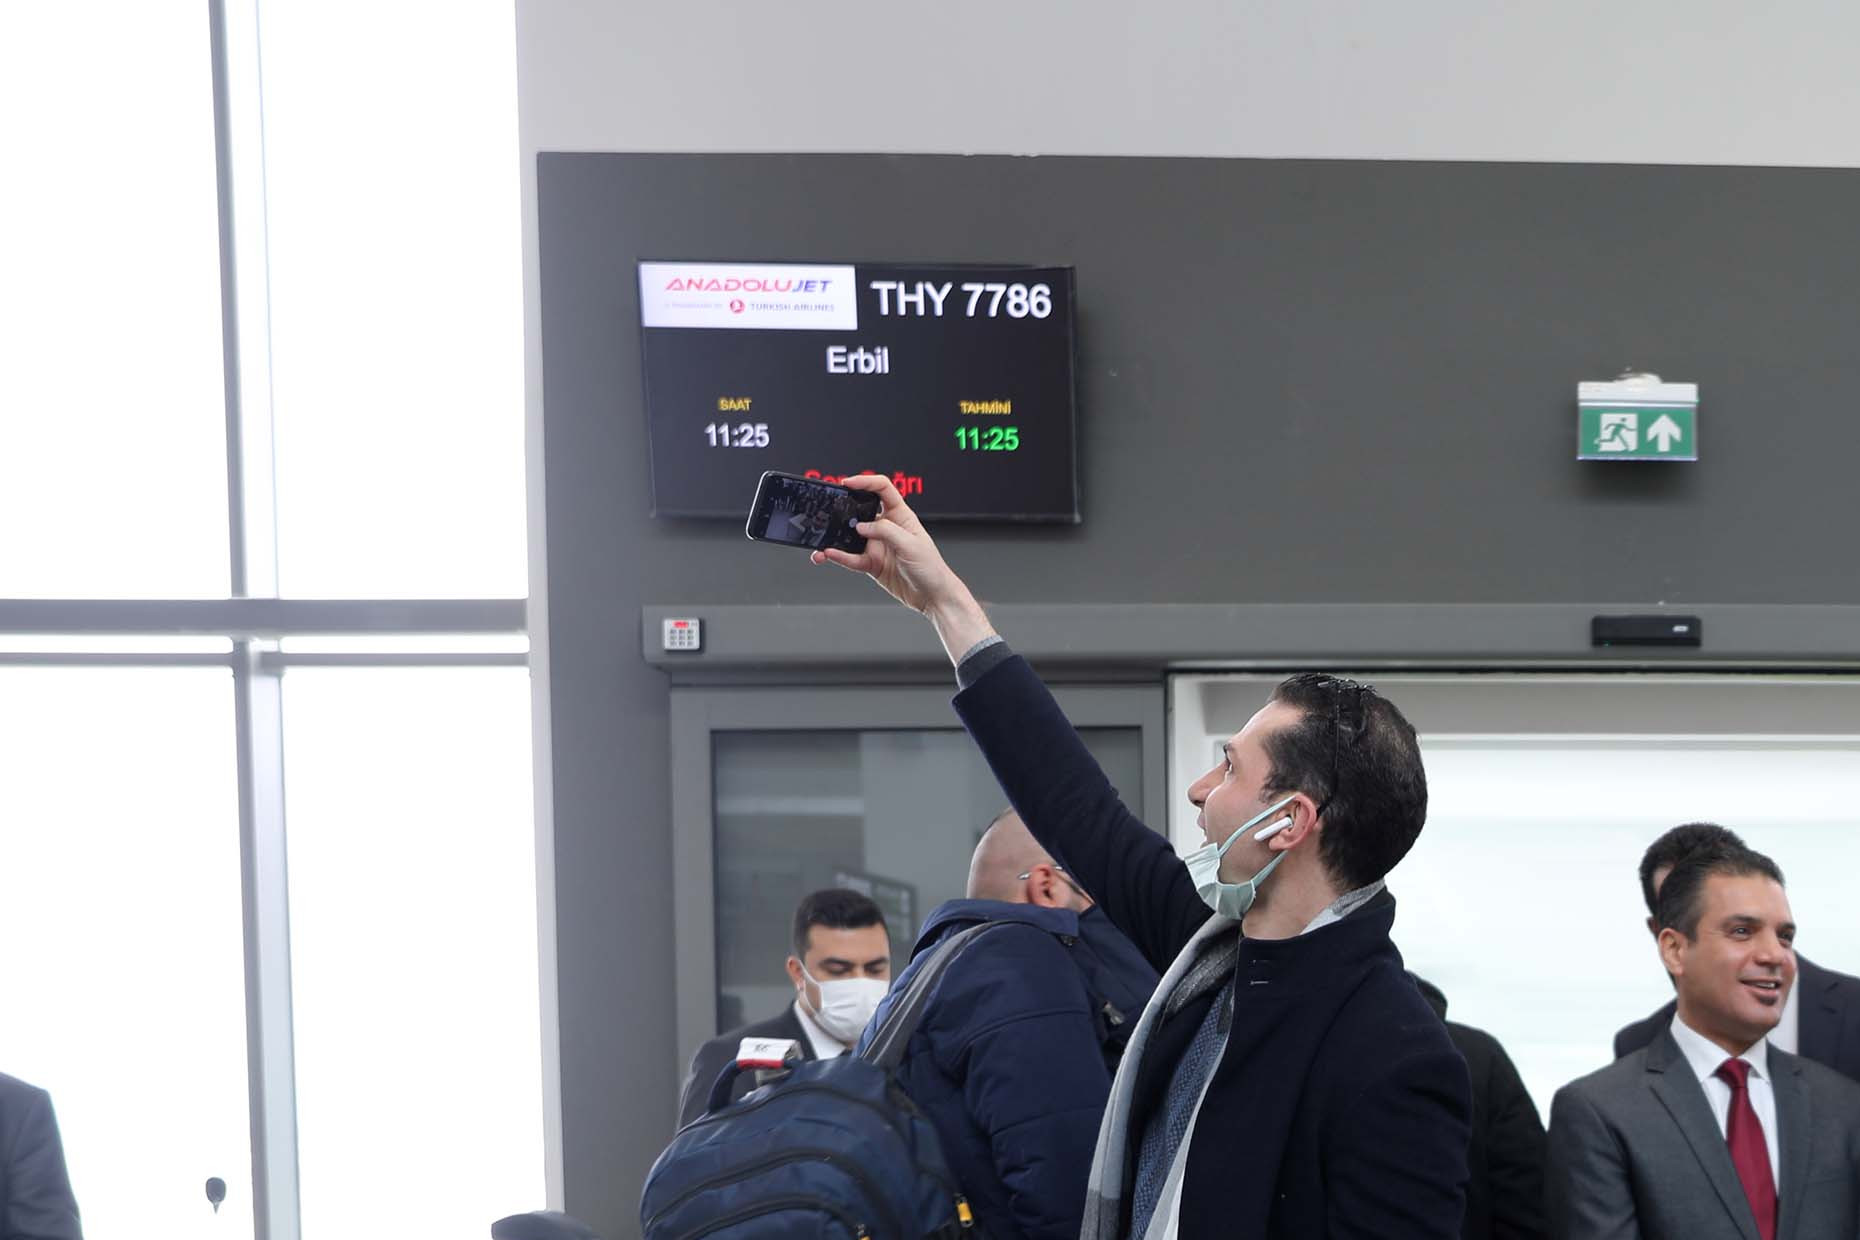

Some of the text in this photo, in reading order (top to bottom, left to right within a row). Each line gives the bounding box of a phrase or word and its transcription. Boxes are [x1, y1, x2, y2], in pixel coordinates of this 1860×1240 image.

[666, 278, 832, 293] ANADOLUJET
[870, 281, 1052, 318] THY 7786
[826, 346, 889, 374] Erbil
[718, 398, 752, 411] SAAT
[959, 400, 1012, 415] TAHMİNİ
[704, 422, 770, 448] 11:25
[954, 425, 1020, 451] 11:25
